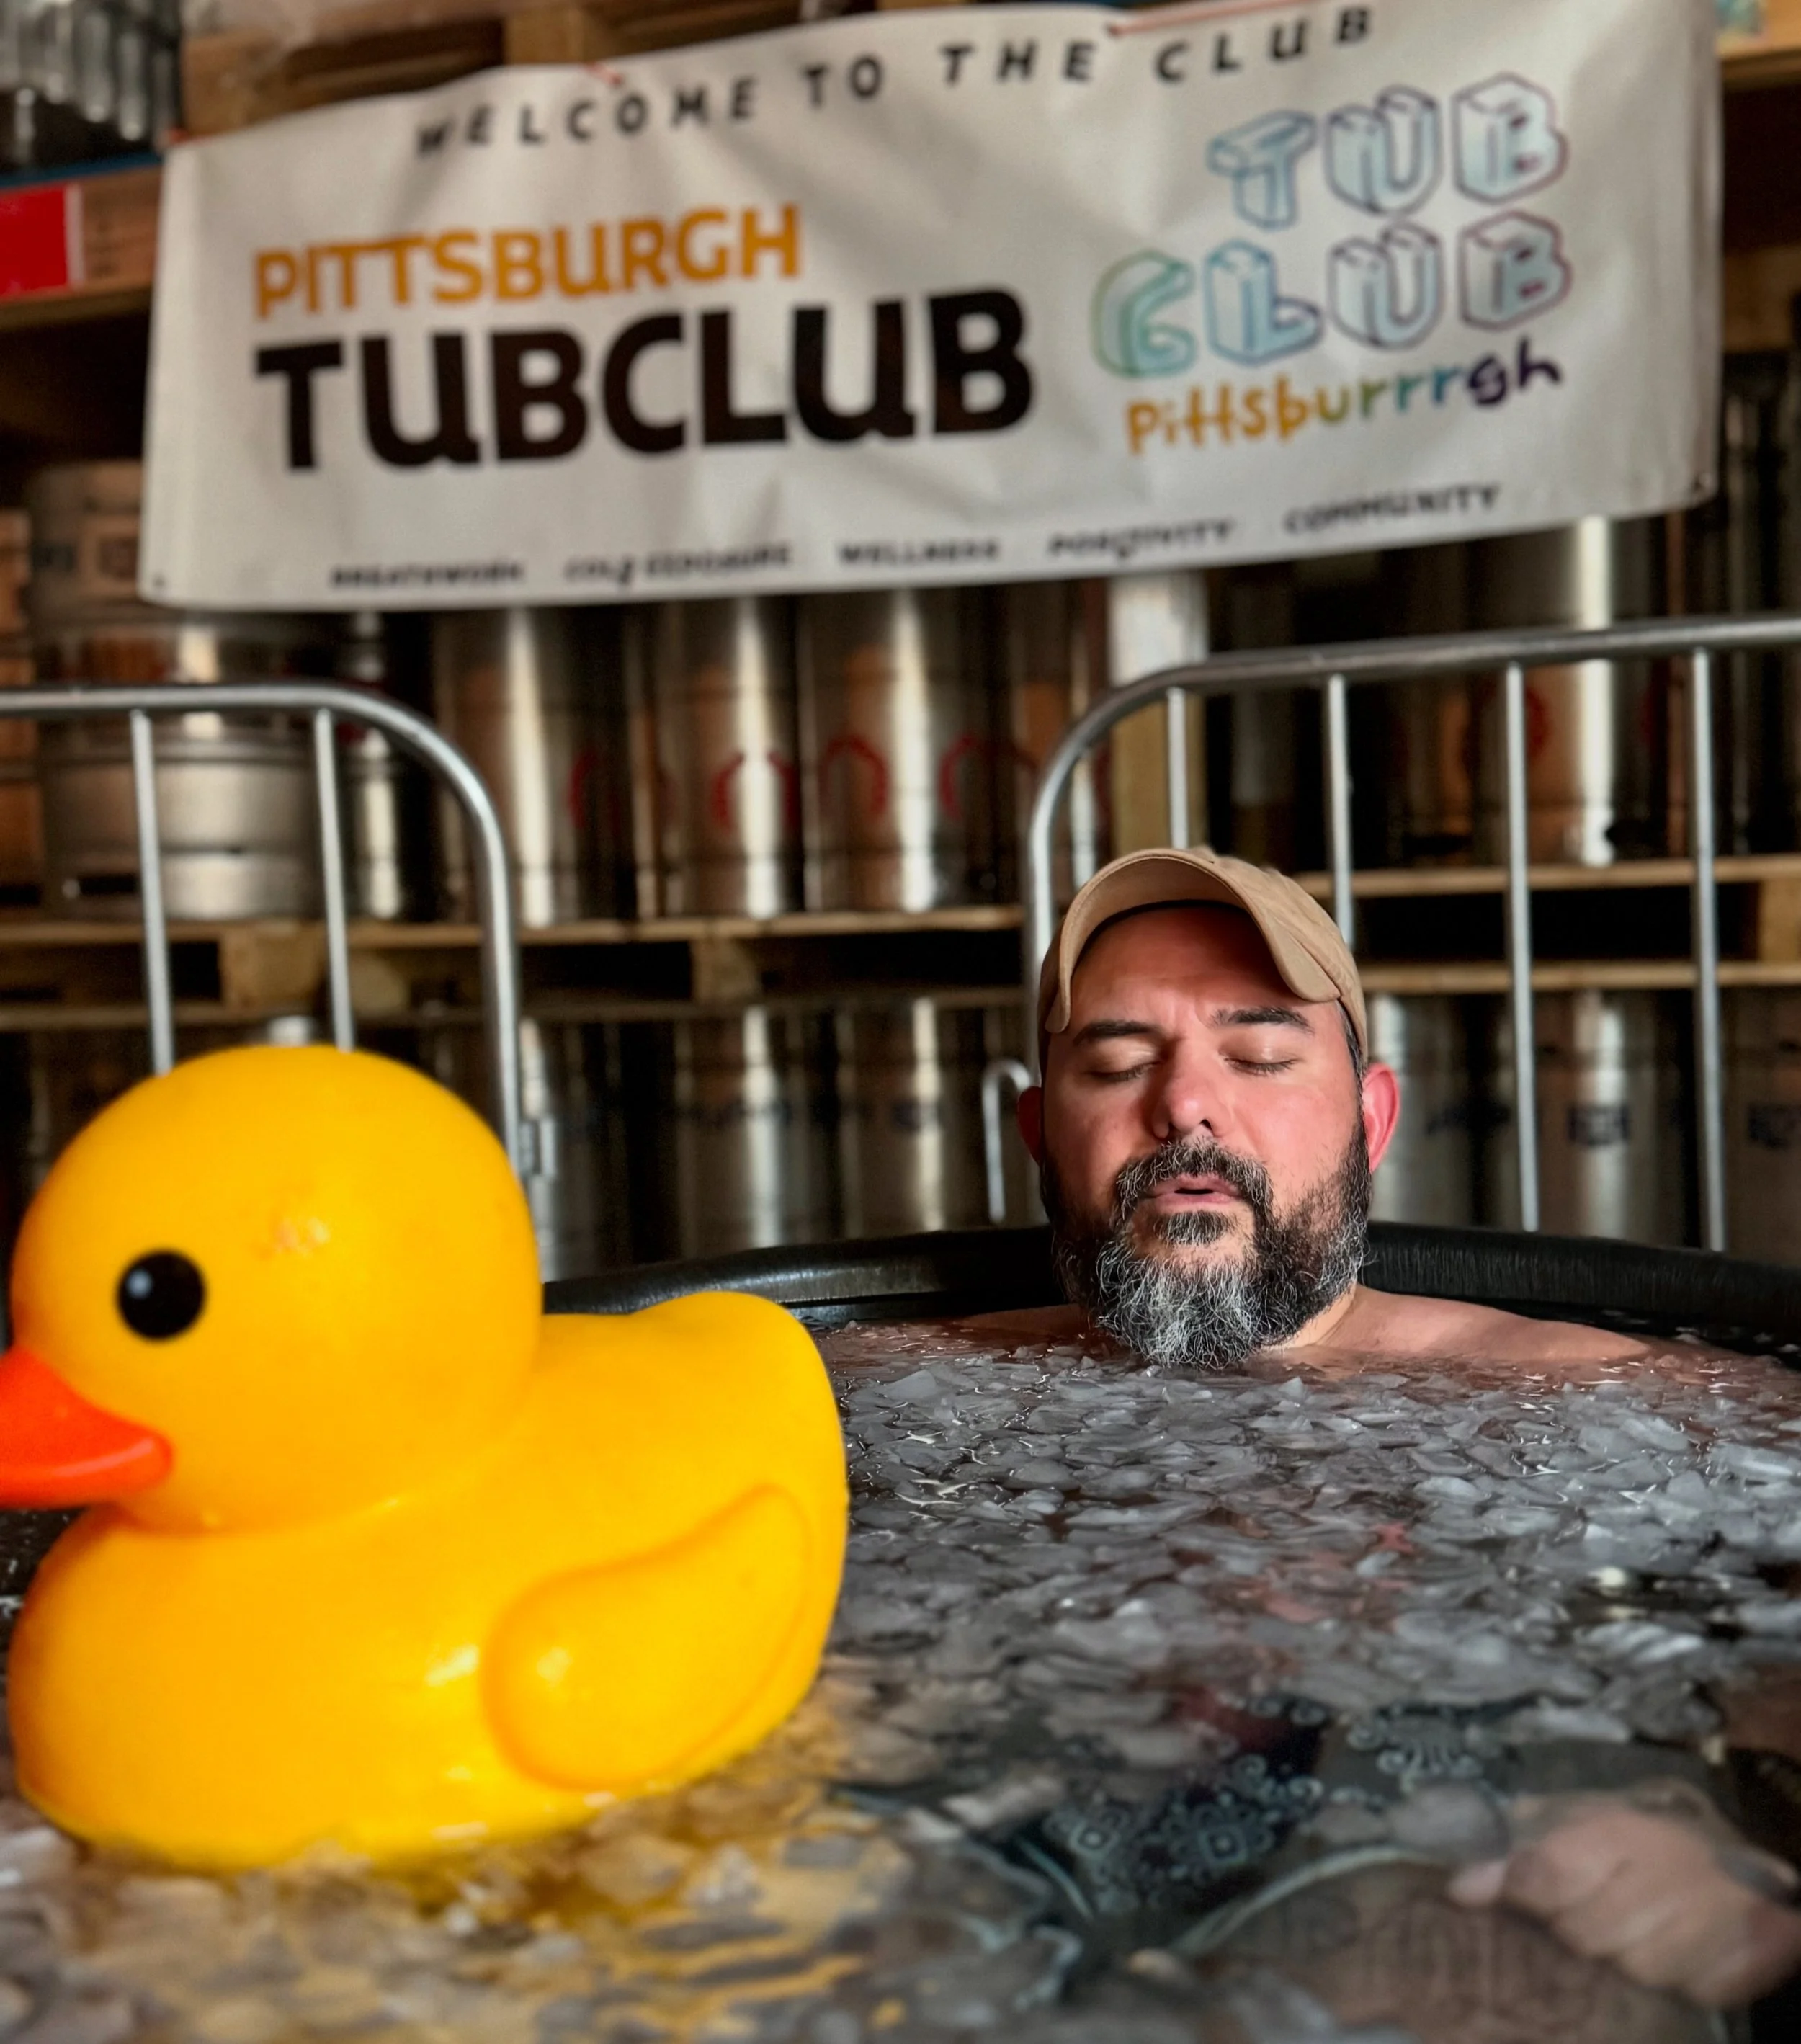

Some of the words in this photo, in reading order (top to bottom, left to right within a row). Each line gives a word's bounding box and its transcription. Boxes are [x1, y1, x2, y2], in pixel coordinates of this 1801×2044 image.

[416, 78, 758, 157] WELCOME
[801, 56, 885, 110] TO
[940, 39, 1098, 84] THE
[1155, 6, 1375, 83] CLUB
[1206, 72, 1569, 232] TUB
[254, 204, 800, 321] PITTSBURGH
[1091, 211, 1574, 380] CLUB
[255, 287, 1034, 473] TUBCLUB
[1126, 334, 1563, 458] pittsburrrgh
[1284, 483, 1503, 535] COMMUNITY
